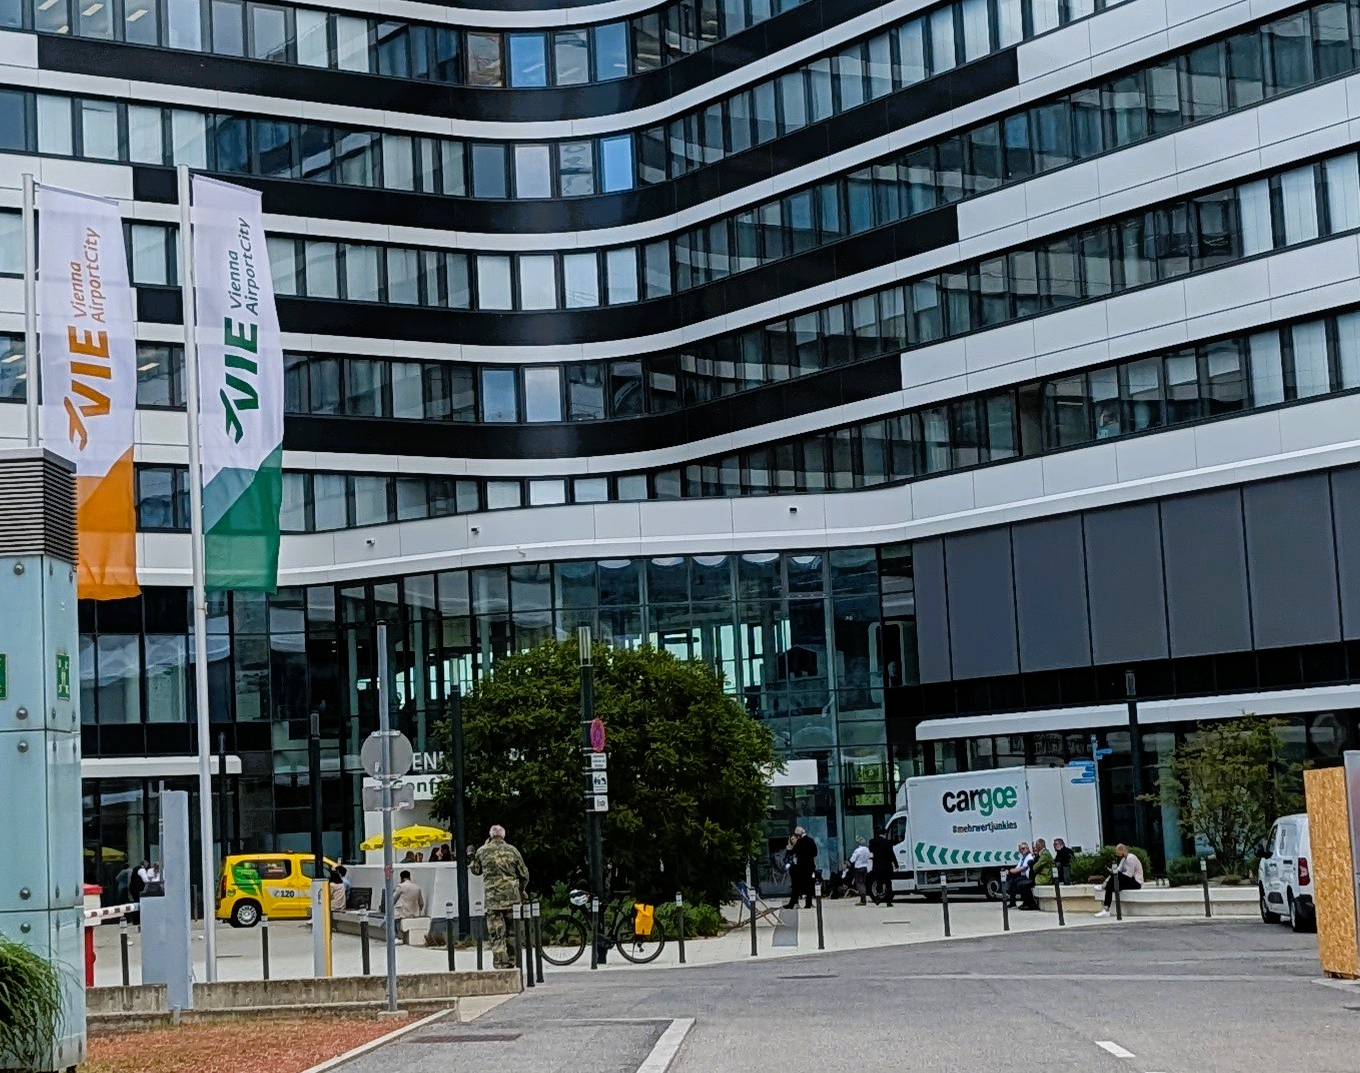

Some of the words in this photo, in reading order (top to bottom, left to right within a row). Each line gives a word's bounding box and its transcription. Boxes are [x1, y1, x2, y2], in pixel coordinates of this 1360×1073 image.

[69, 261, 85, 319] Vienna
[84, 227, 107, 324] AirportCity
[227, 250, 242, 309] Vienna
[239, 217, 259, 316] AirportCity
[67, 325, 112, 417] VIE
[224, 316, 259, 411] VIE
